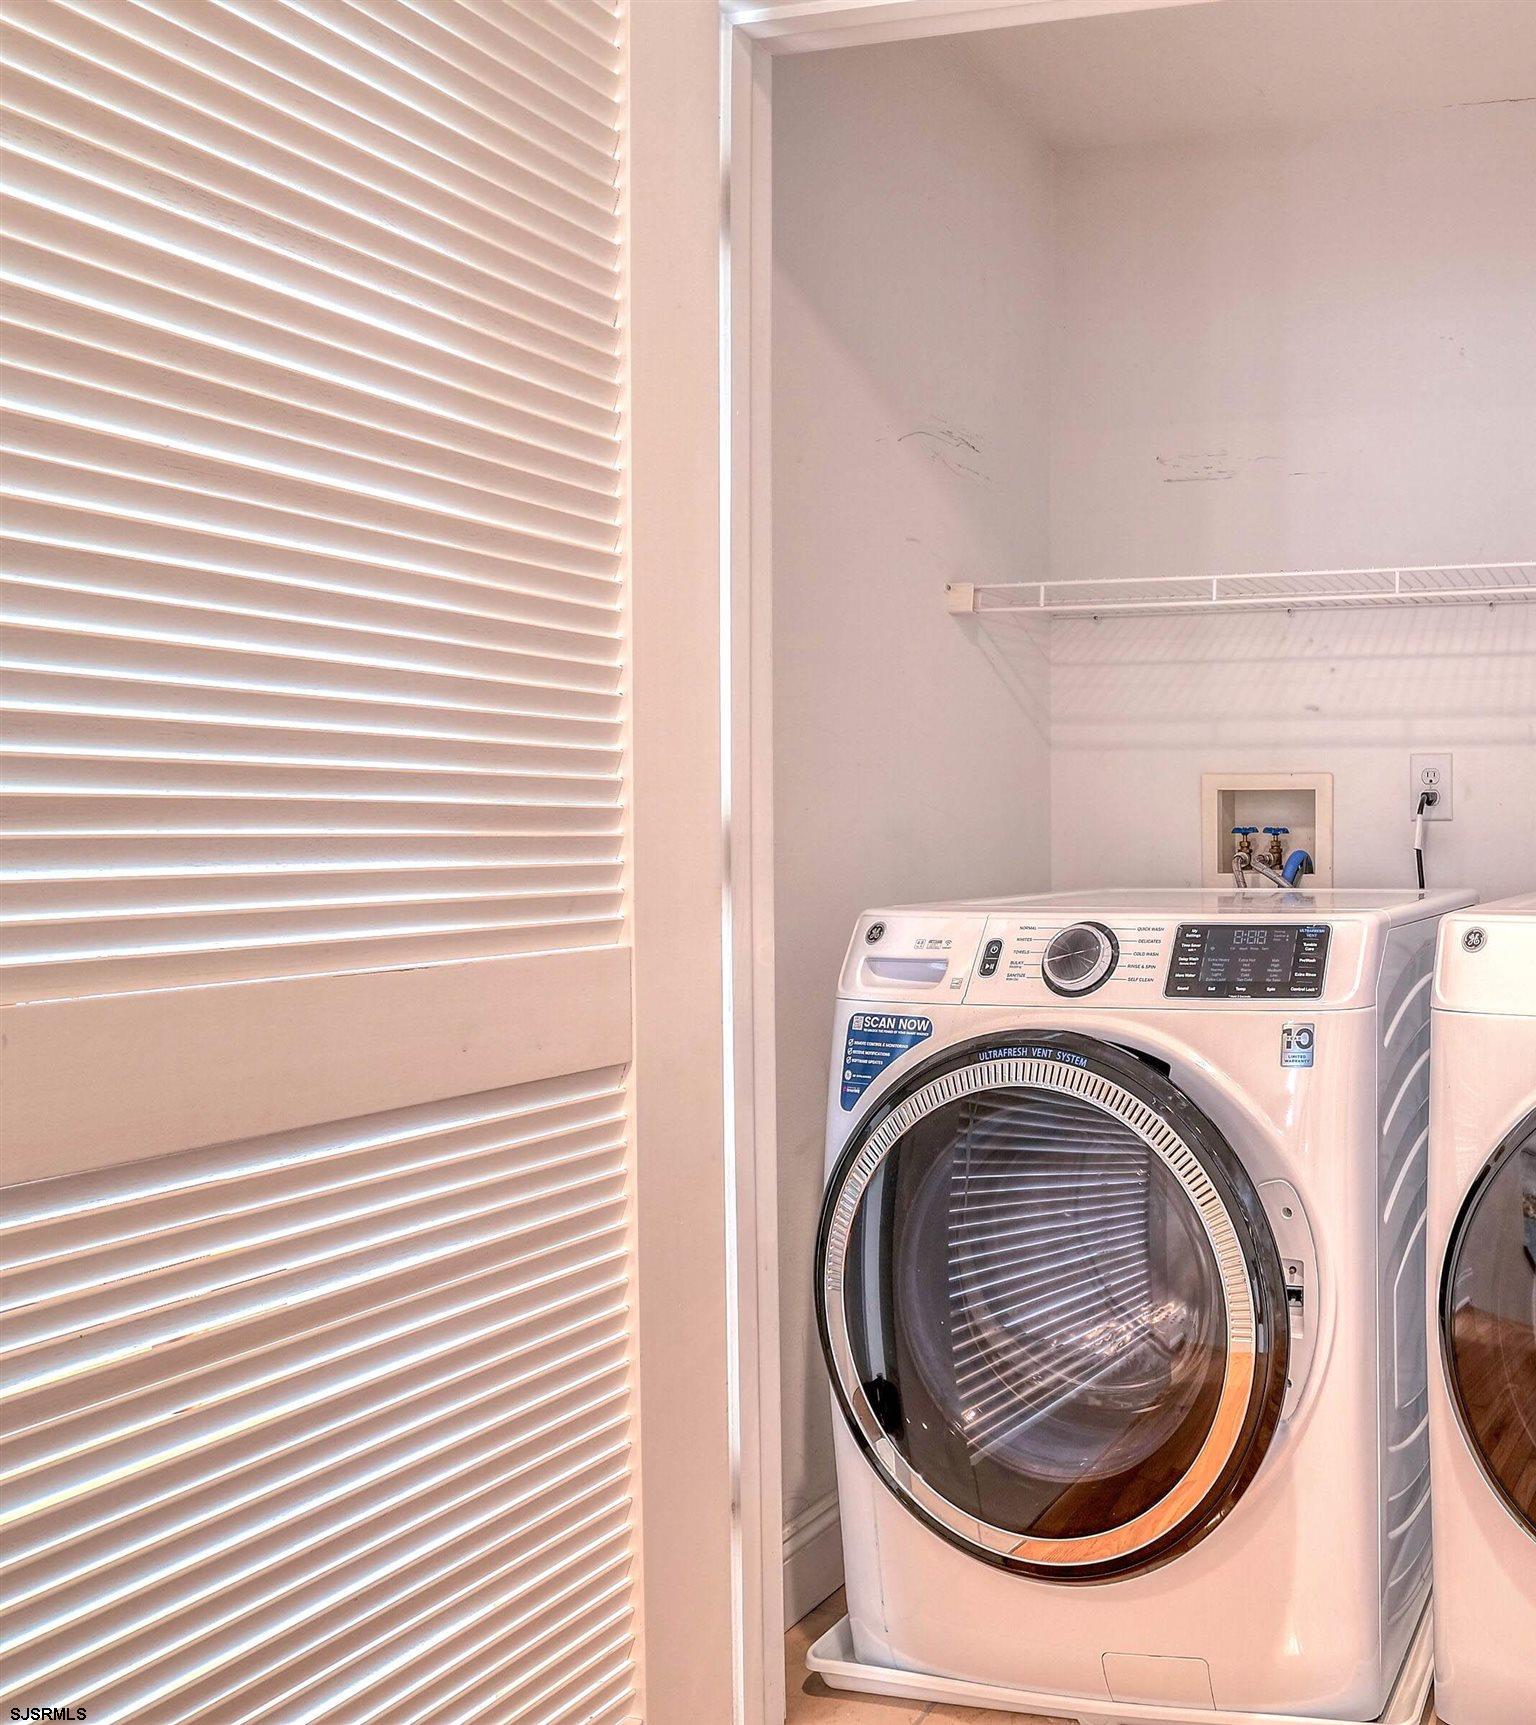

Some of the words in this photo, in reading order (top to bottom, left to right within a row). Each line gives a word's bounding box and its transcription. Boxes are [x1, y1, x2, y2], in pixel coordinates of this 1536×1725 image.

[864, 1016, 896, 1029] SCAN
[898, 1018, 930, 1032] NOW
[1282, 1028, 1314, 1050] 10
[979, 1047, 1028, 1061] ULTRAFRESH
[1032, 1048, 1053, 1059] VENT
[1056, 1051, 1088, 1068] SYSTEM
